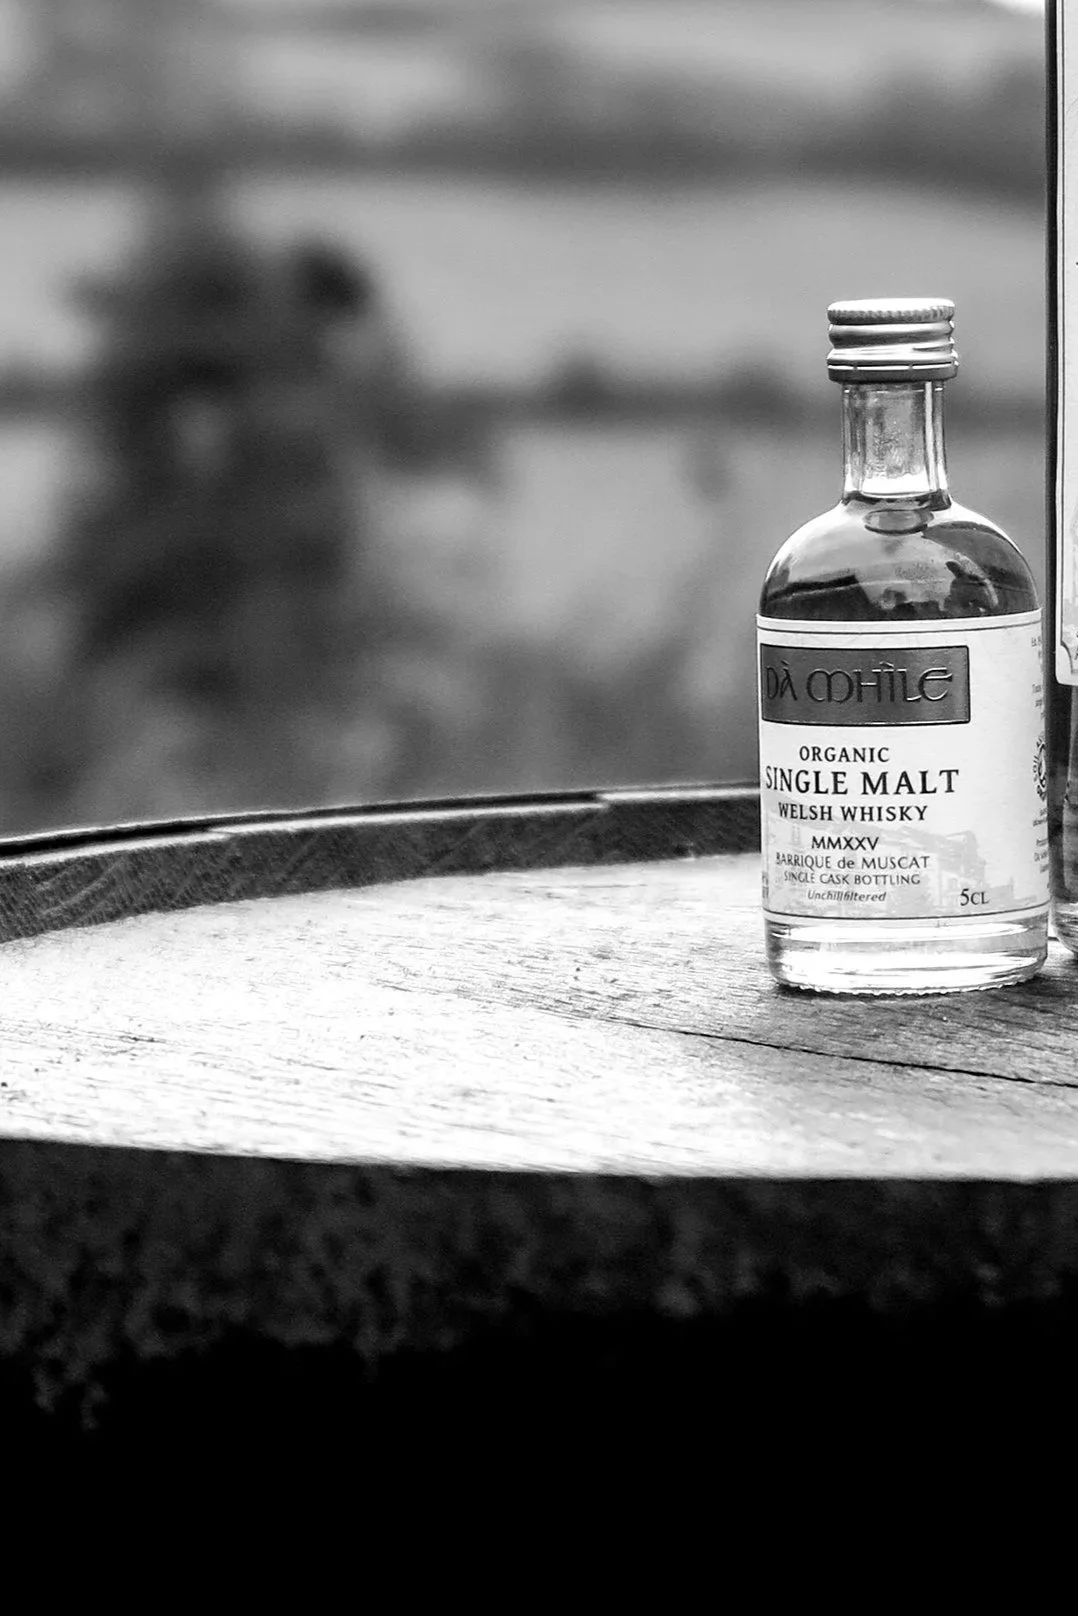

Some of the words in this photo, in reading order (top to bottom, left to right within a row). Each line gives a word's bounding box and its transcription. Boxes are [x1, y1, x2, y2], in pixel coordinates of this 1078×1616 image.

[799, 745, 890, 763] ORGANIC
[766, 765, 848, 795] SINGLE
[861, 769, 959, 796] MALT
[778, 802, 833, 821] WELSH
[840, 804, 928, 822] WHISKY
[811, 835, 880, 851] MMXXV
[776, 852, 831, 872] BARRIQUE
[837, 856, 855, 870] de
[861, 856, 930, 870] MUSCAT
[784, 871, 815, 884] SINGLE
[819, 873, 849, 885] CASK
[854, 874, 921, 885] BOTTLING
[807, 890, 887, 902] Unchillfiltered
[959, 888, 990, 907] 5CL
